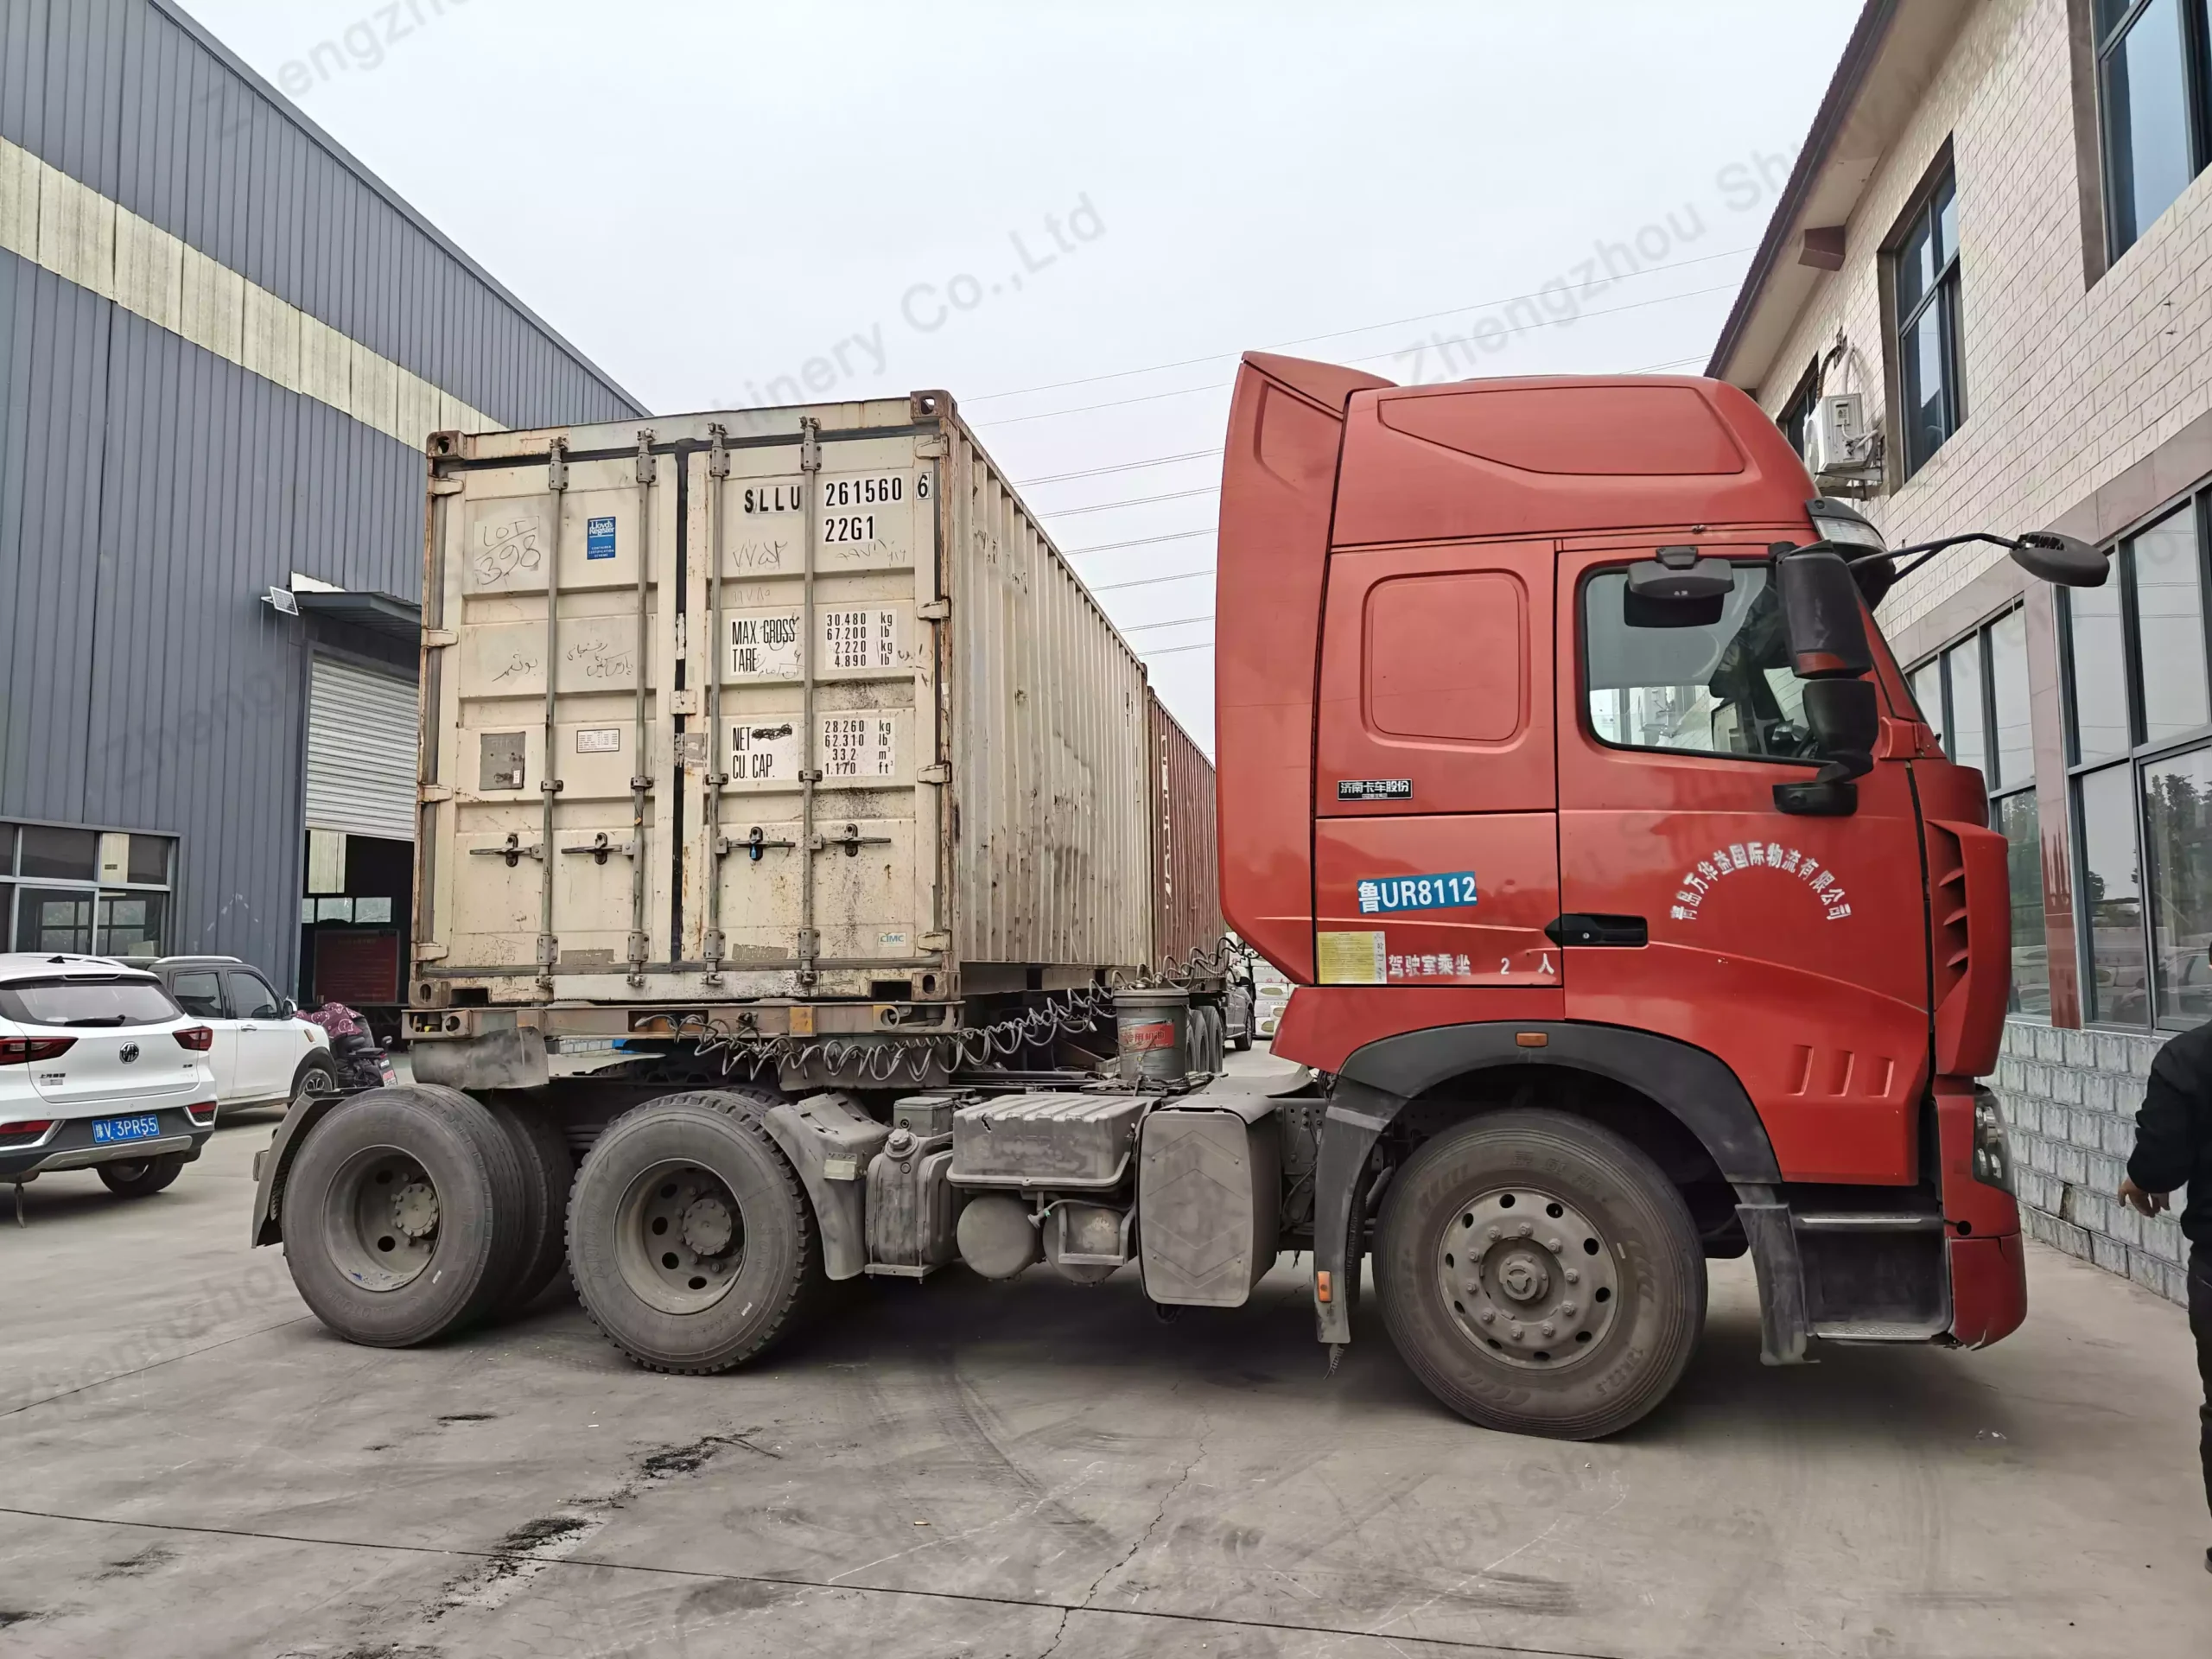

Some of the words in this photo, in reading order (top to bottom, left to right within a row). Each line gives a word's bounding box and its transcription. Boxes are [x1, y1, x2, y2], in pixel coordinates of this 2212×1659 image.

[744, 486, 800, 513] SLLU
[825, 477, 902, 507] 261560
[917, 475, 928, 498] 6
[825, 516, 874, 543] 22G1
[480, 534, 541, 585] 398
[826, 613, 867, 626] 30.480
[880, 612, 893, 626] kg
[732, 620, 760, 645] MAX.
[763, 618, 796, 644] GROSS
[826, 626, 867, 640] 67.200
[880, 626, 890, 638] lb
[835, 640, 867, 654] 2.220
[880, 641, 893, 654] kg
[732, 648, 758, 672] TARE
[834, 654, 867, 668] 4.890
[880, 654, 890, 665] lb
[825, 720, 865, 734] 28.260
[879, 720, 891, 734] kg
[732, 727, 752, 752] NET
[825, 734, 864, 747] 62.310
[879, 734, 888, 746] lb
[832, 748, 856, 761] 33.2
[733, 754, 748, 779] CU.
[752, 753, 775, 779] CAP.
[825, 762, 856, 775] 1.170
[1340, 780, 1409, 794] 济南卡车股份
[1357, 876, 1478, 913] 鲁UR8112
[1389, 953, 1471, 977] 驾驶室乘坐
[1500, 957, 1510, 976] 2
[1538, 953, 1555, 975] 人
